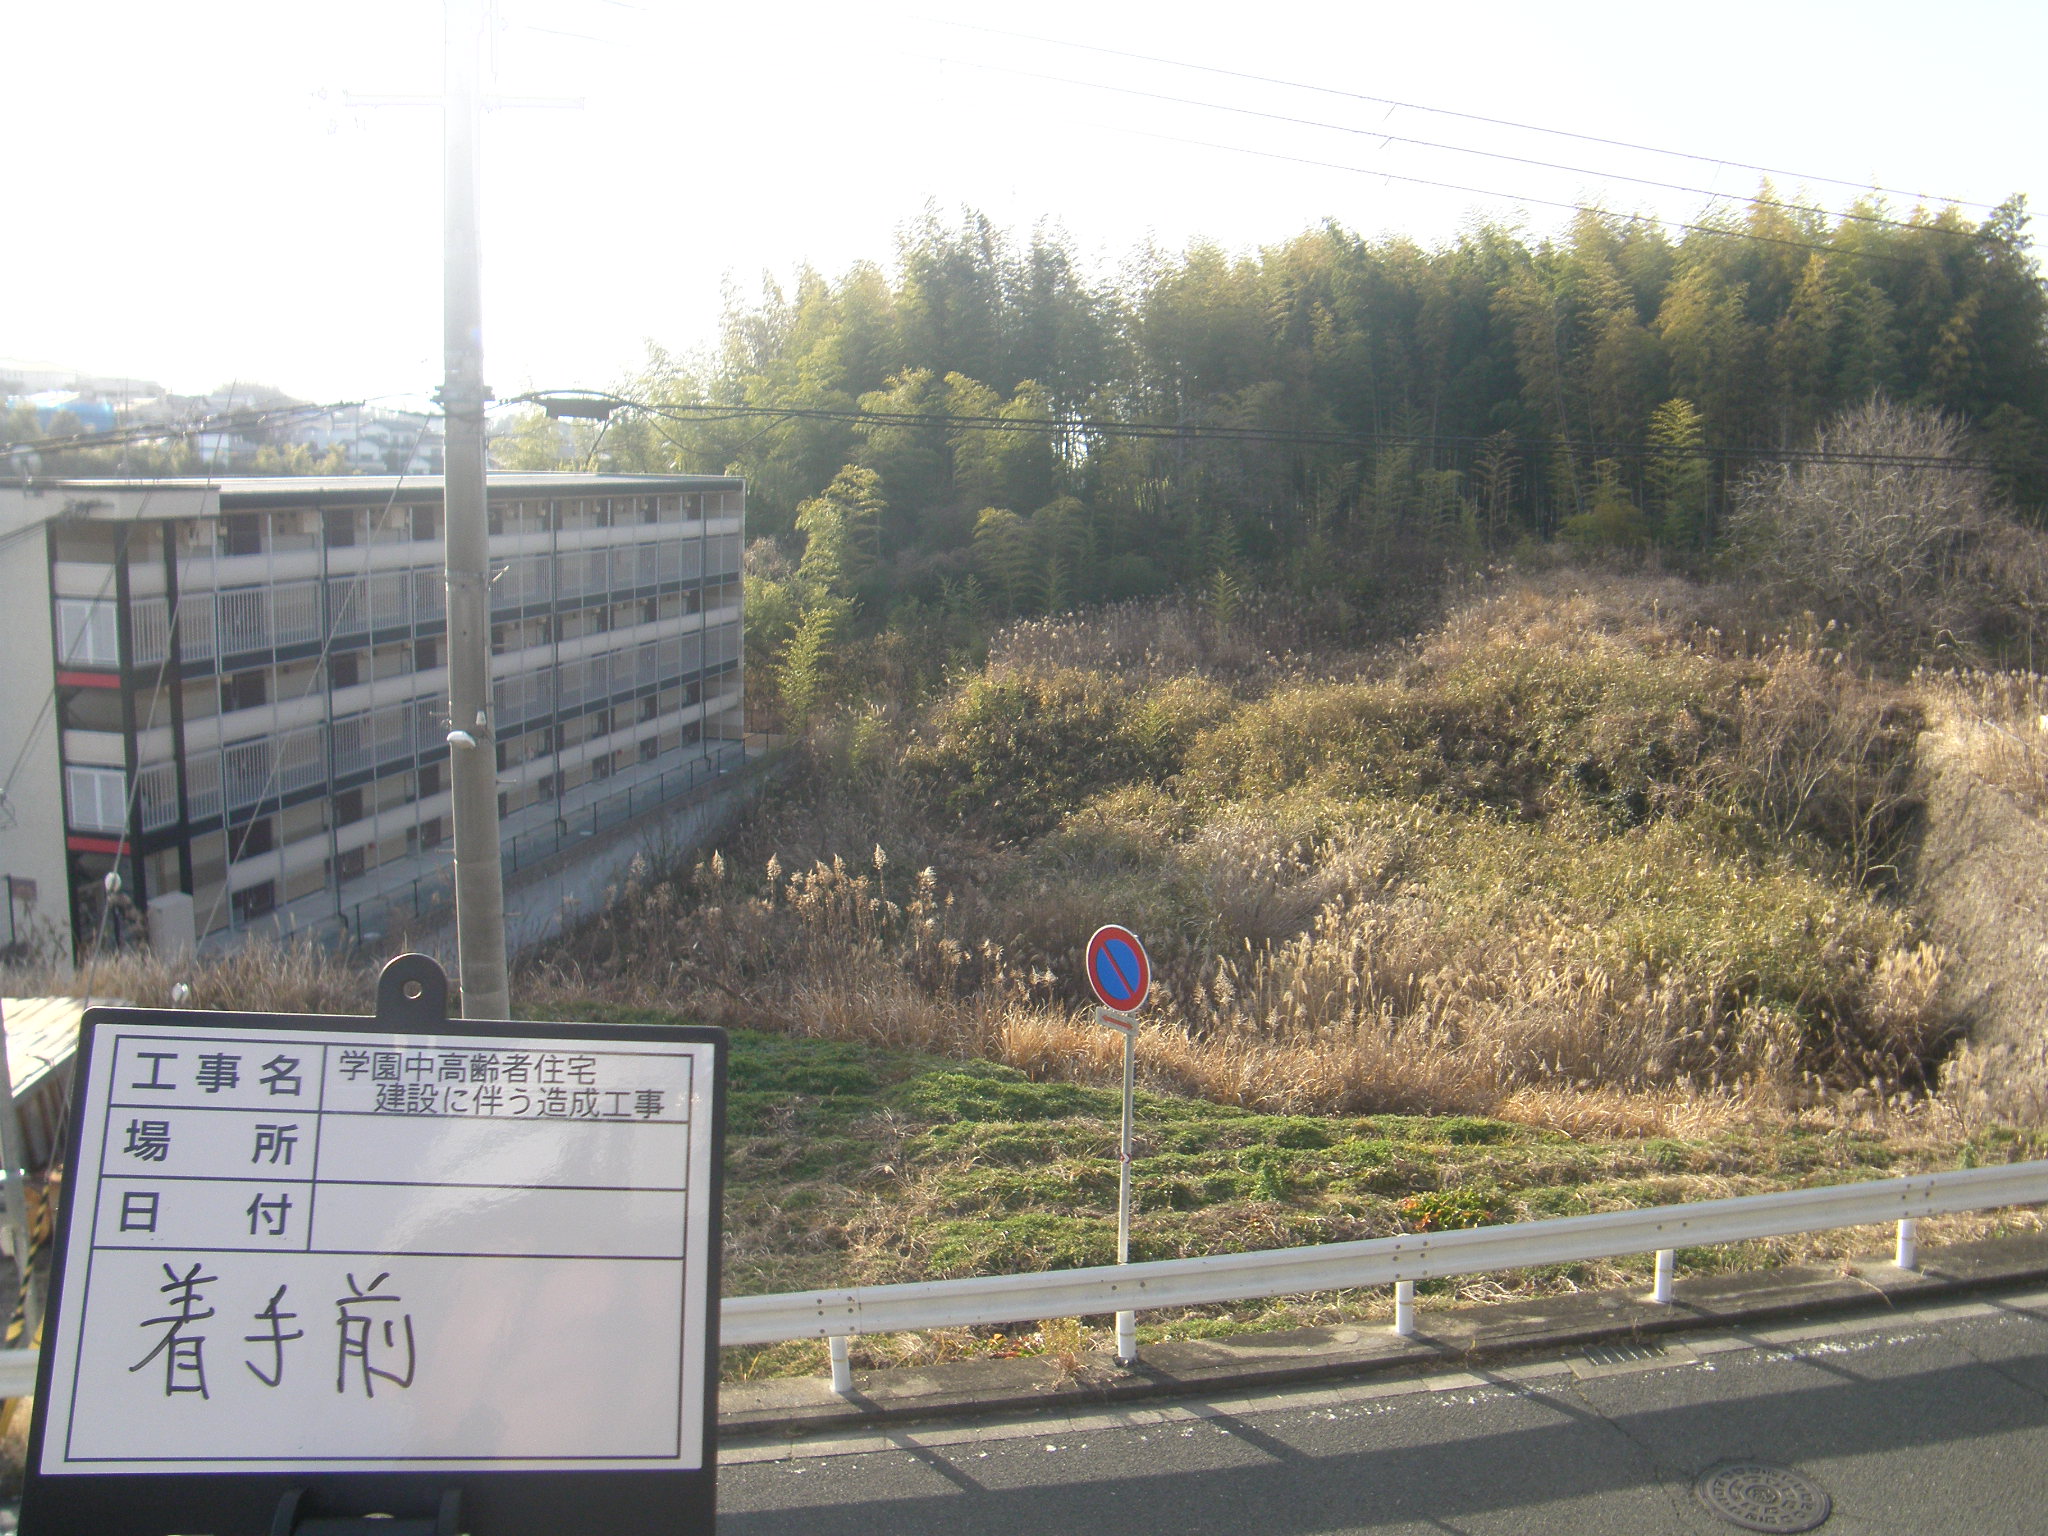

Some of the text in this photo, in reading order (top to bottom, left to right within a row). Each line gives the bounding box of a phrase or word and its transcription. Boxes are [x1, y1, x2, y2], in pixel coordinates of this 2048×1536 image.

[133, 1052, 303, 1096] 工事名
[339, 1052, 597, 1085] 学園中高齢者住宅
[374, 1088, 665, 1119] 建設に伴う造成工事
[129, 1262, 416, 1400] 着手前
